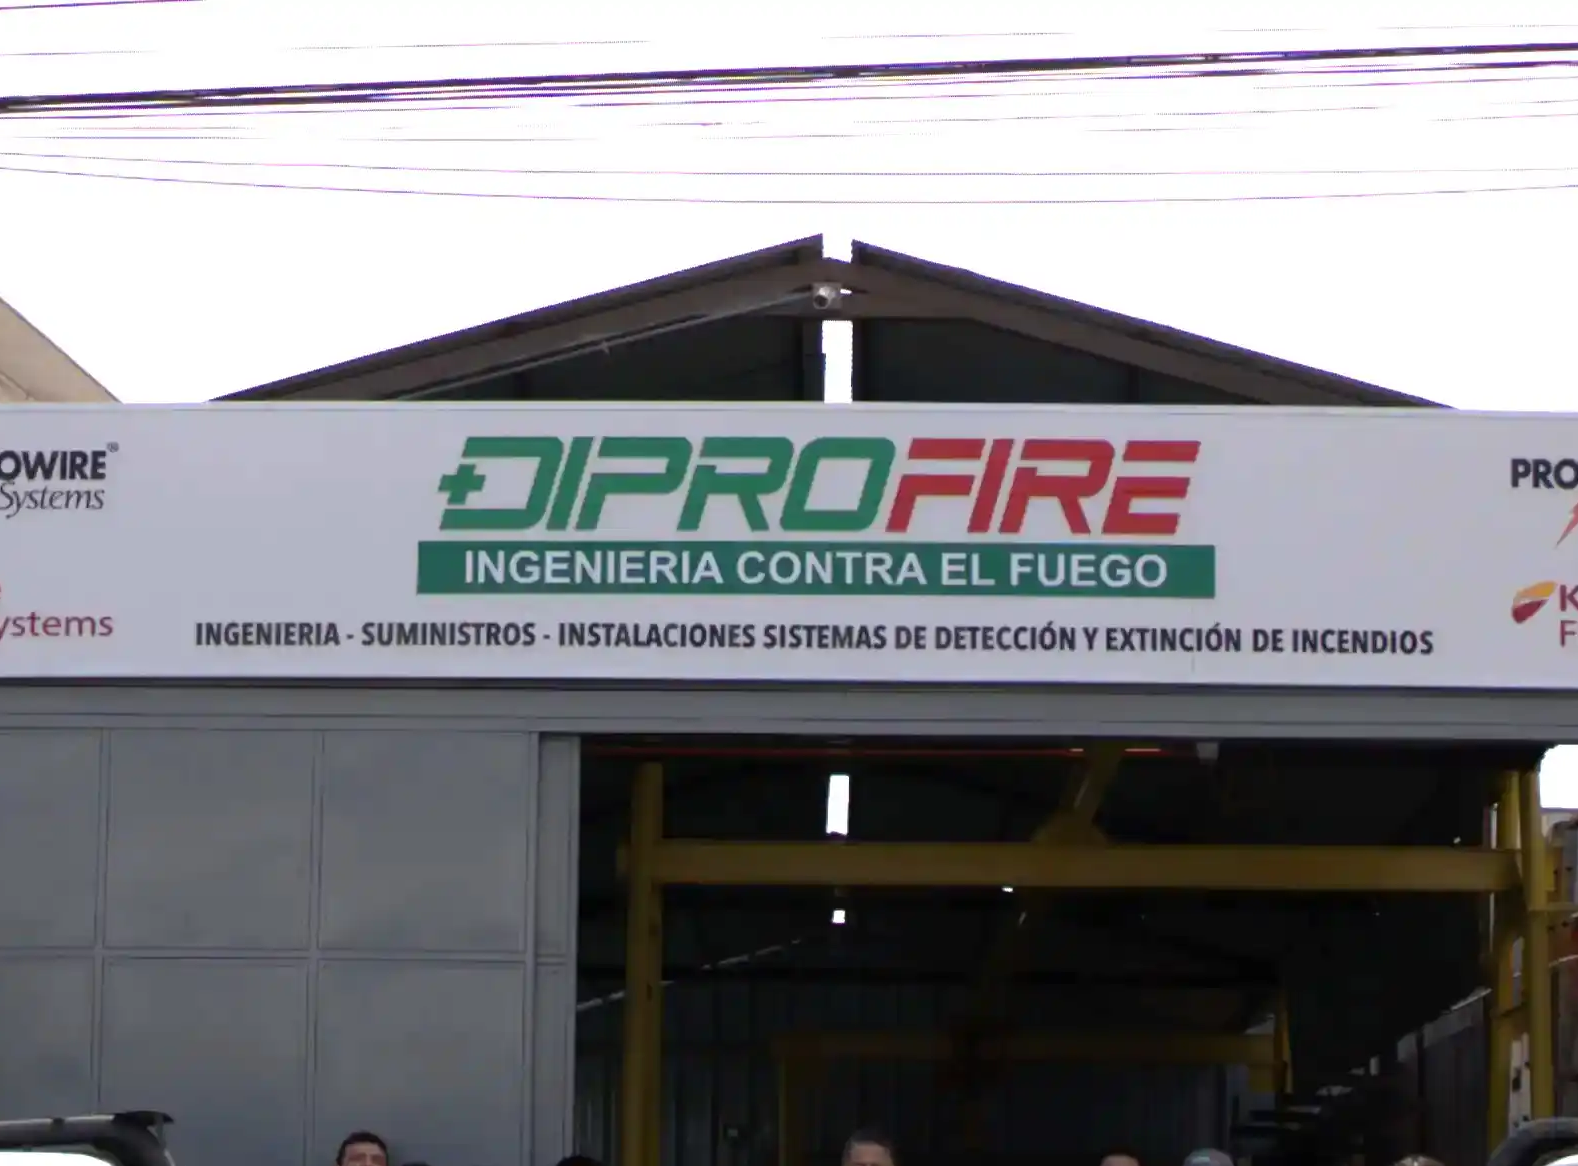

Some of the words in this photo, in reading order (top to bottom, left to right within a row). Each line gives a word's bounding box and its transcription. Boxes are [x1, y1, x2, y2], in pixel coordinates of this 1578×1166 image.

[438, 437, 1201, 534] DIPROFIRE
[464, 550, 724, 584] INGENIERIA
[736, 550, 928, 585] CONTRA
[940, 552, 996, 586] EL
[1009, 552, 1168, 588] FUEGO
[195, 621, 341, 647] INGENIERIA
[361, 621, 536, 647] SUMINISTROS
[558, 622, 756, 649] INSTALACIONES
[762, 624, 888, 650] SISTEMAS
[894, 626, 928, 650] DE
[934, 621, 1077, 652] DETECCIÓN
[1082, 626, 1099, 651] Y
[1105, 622, 1242, 653] EXTINCIÓN
[1251, 628, 1285, 653] DE
[1291, 628, 1434, 655] INCENDIOS
